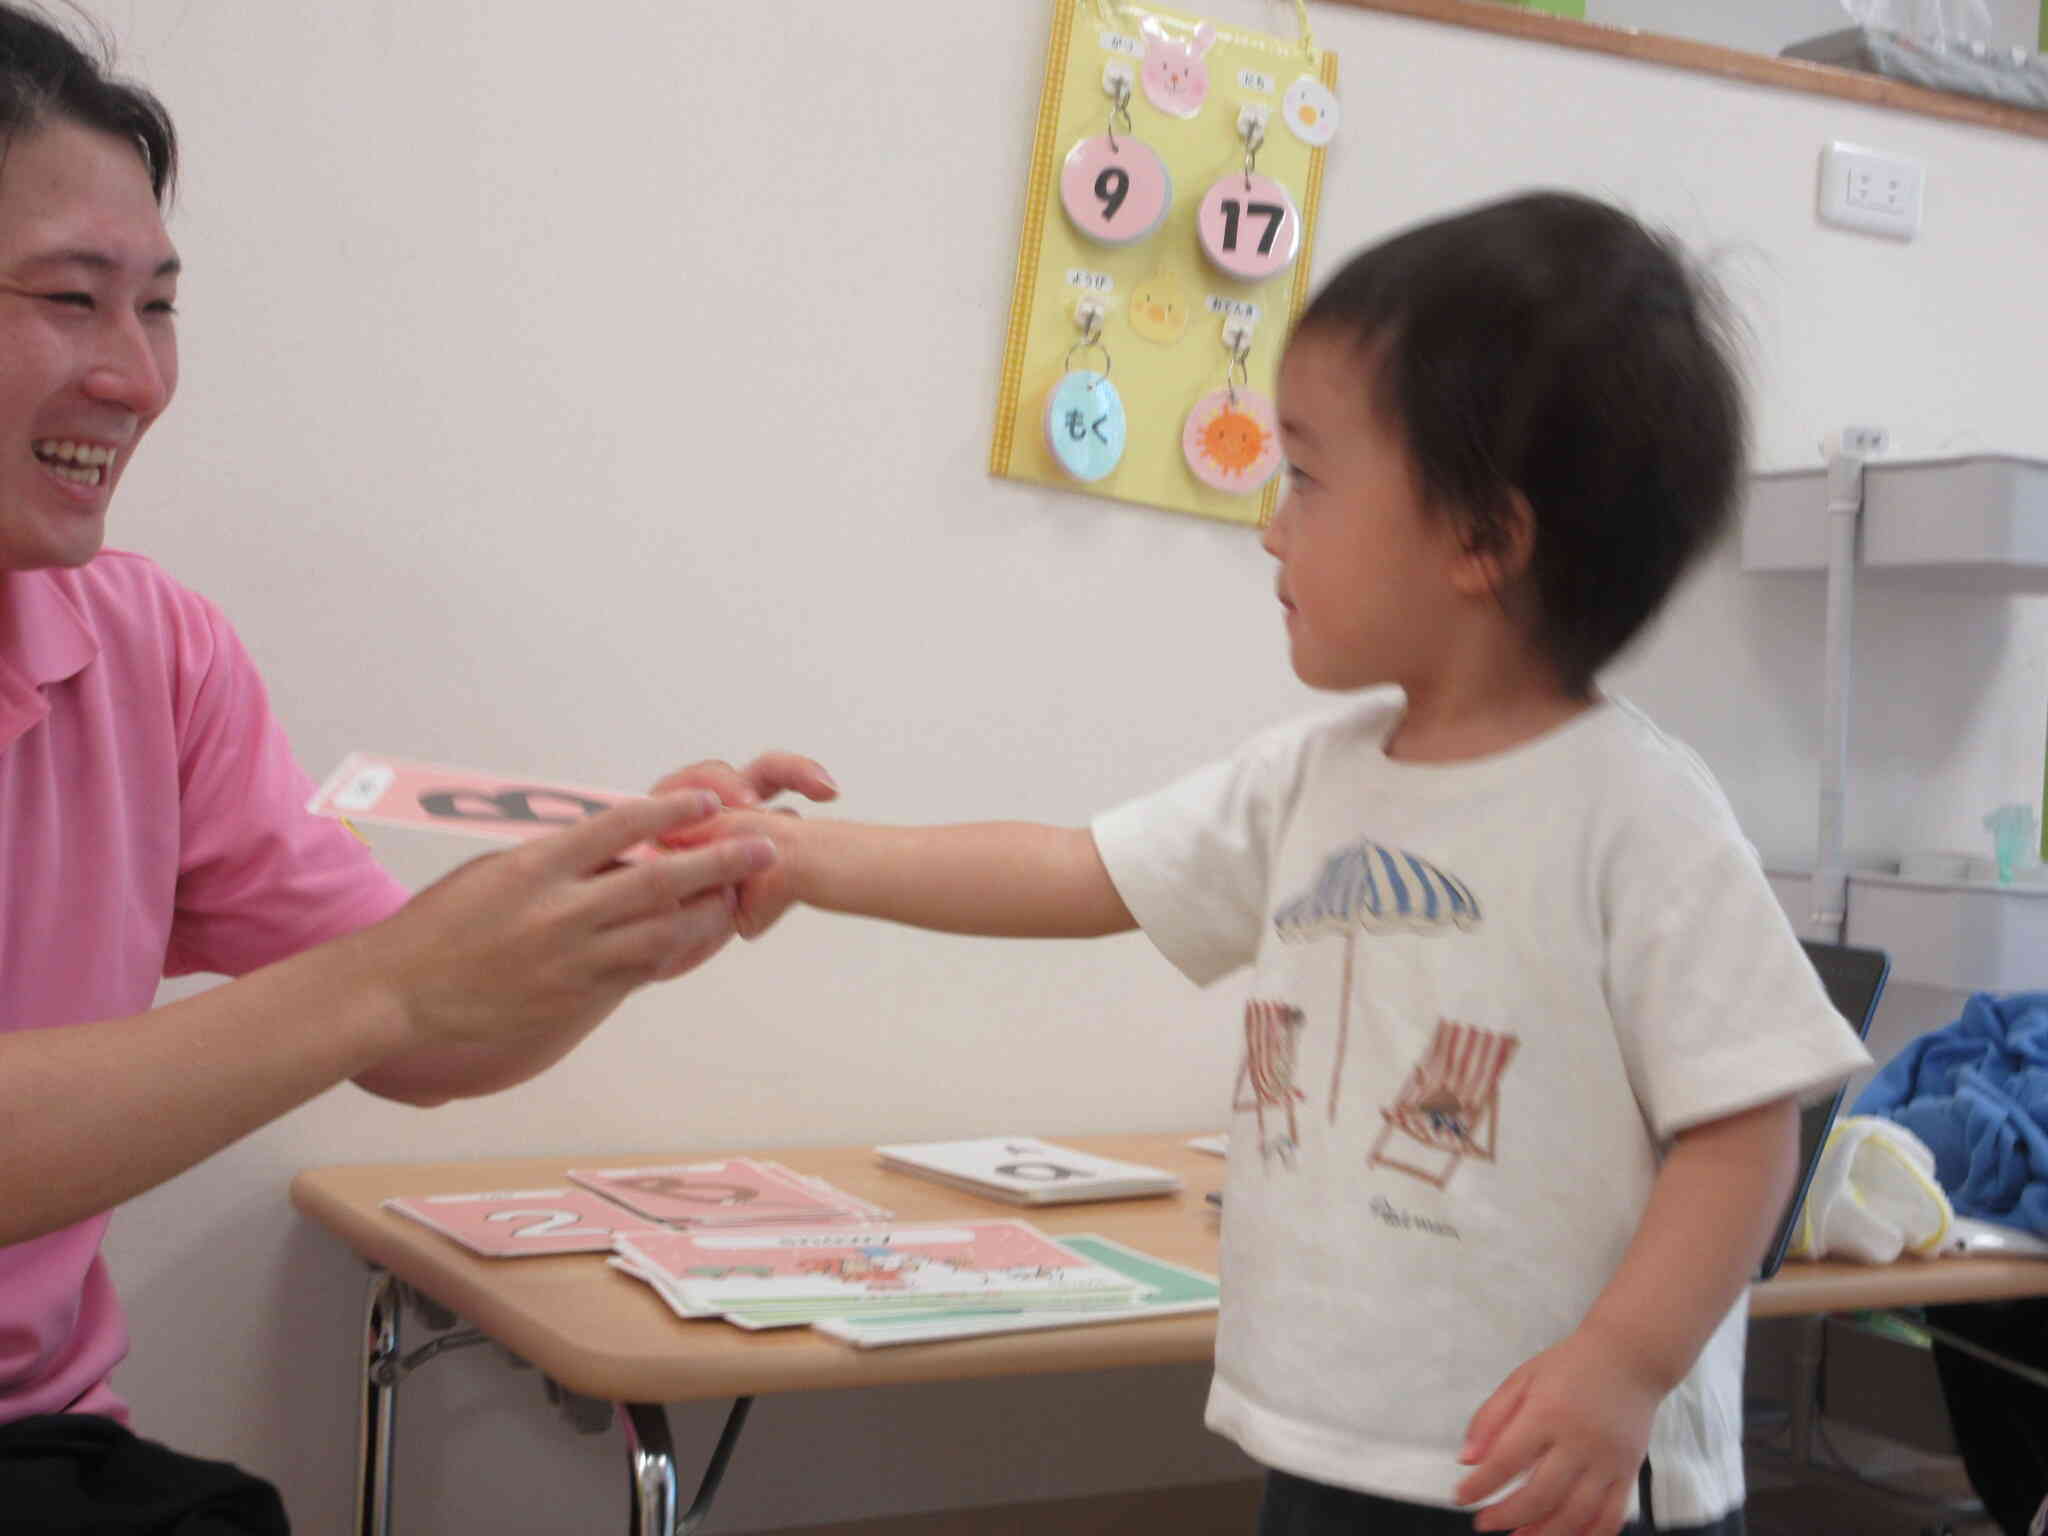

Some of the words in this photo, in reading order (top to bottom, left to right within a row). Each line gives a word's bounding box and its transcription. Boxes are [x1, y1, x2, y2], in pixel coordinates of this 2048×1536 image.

[1094, 166, 1129, 221] 9
[1221, 199, 1285, 255] 17
[1064, 407, 1109, 446] もく
[484, 1208, 614, 1238] 2
